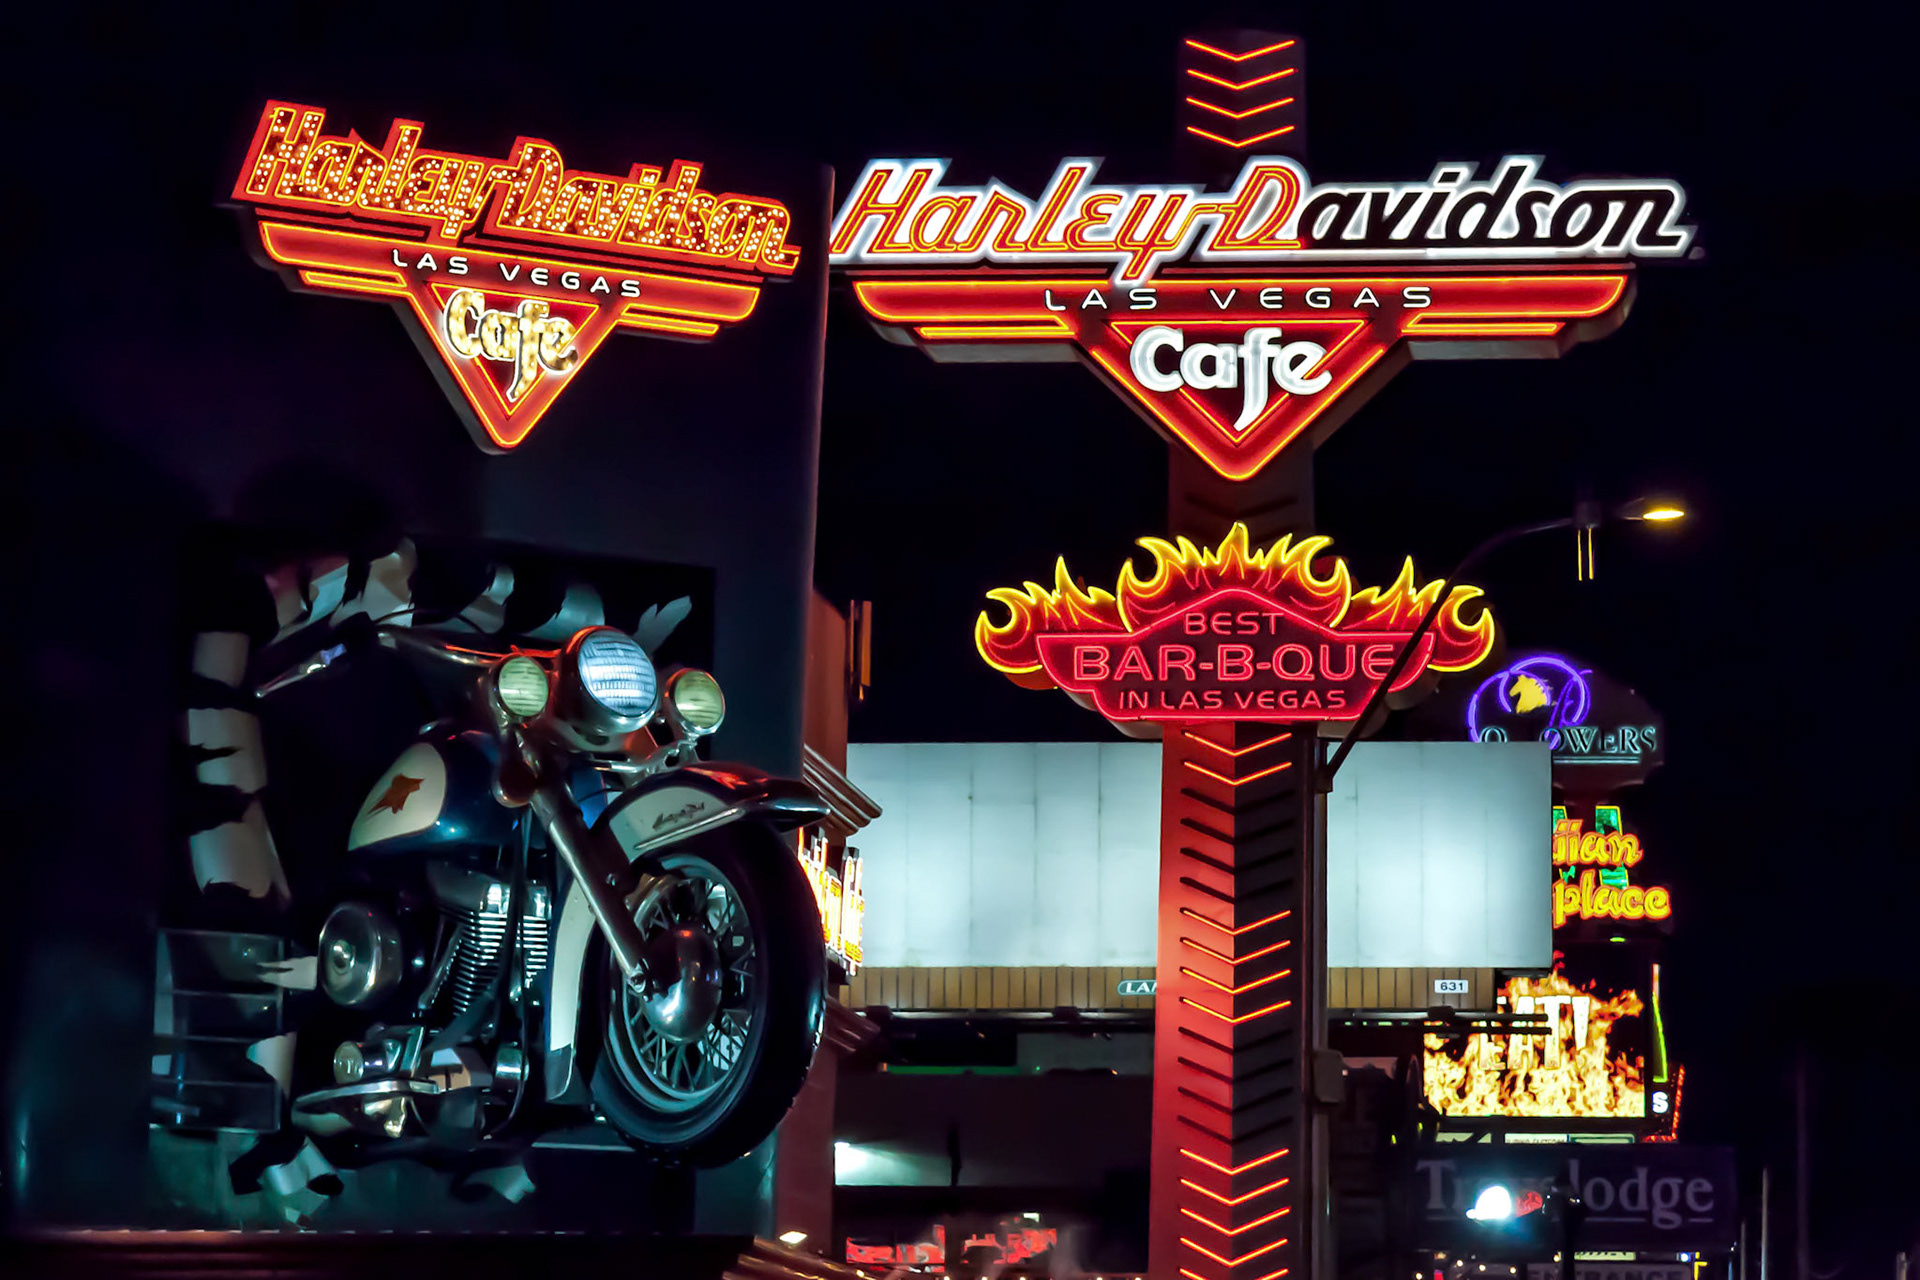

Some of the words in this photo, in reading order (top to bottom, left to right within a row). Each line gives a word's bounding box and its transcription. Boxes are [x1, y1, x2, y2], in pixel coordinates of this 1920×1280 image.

[392, 248, 470, 276] LAS
[498, 263, 642, 299] VEGAS
[1044, 288, 1158, 312] LAS
[1209, 286, 1433, 311] VEGAS
[442, 287, 579, 402] Cafe
[1129, 325, 1333, 433] Cafe
[1183, 611, 1285, 636] BEST
[1073, 643, 1396, 682] BAR-B-QUE
[1118, 689, 1138, 710] IN
[1160, 689, 1224, 710] LAS
[1234, 689, 1347, 710] VEGAS
[1440, 981, 1464, 991] 631
